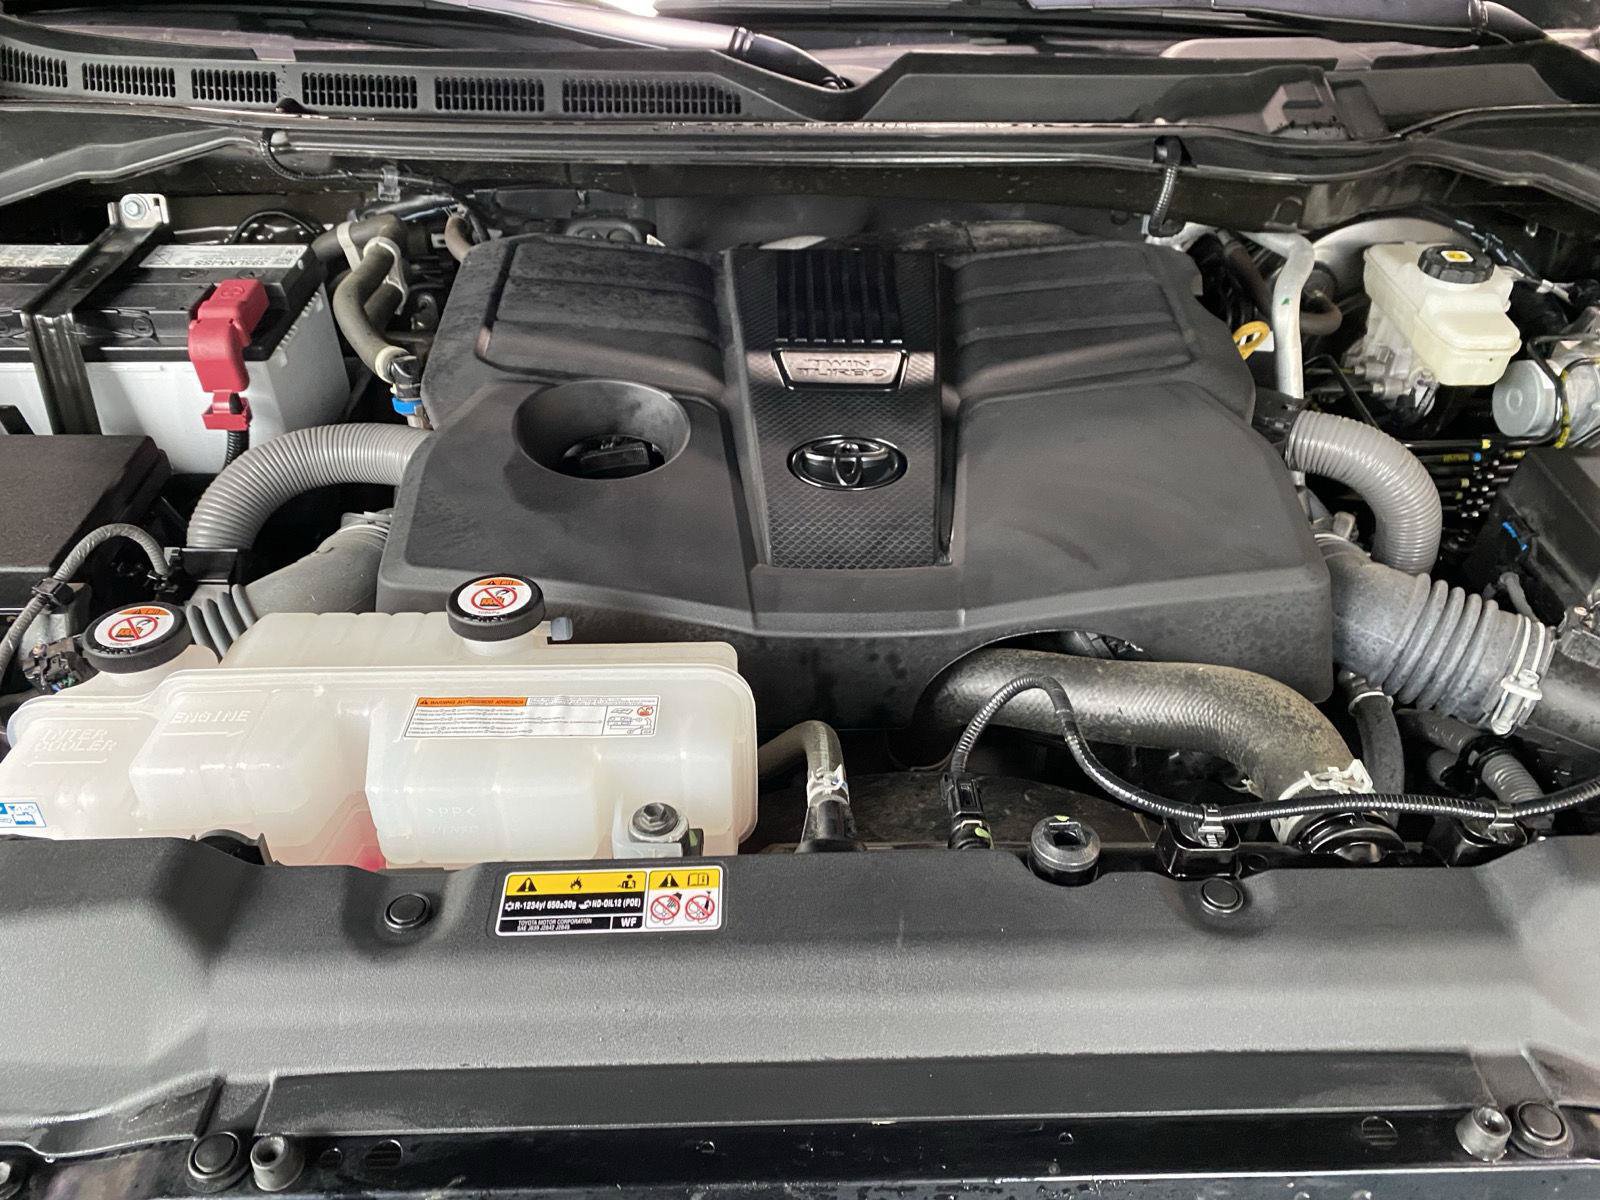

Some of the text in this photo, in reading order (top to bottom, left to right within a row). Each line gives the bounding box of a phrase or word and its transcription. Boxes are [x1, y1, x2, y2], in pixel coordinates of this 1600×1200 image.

[805, 359, 871, 367] TWIN
[796, 368, 888, 377] TURBO
[170, 711, 251, 725] ENGINE
[621, 917, 637, 928] WF
